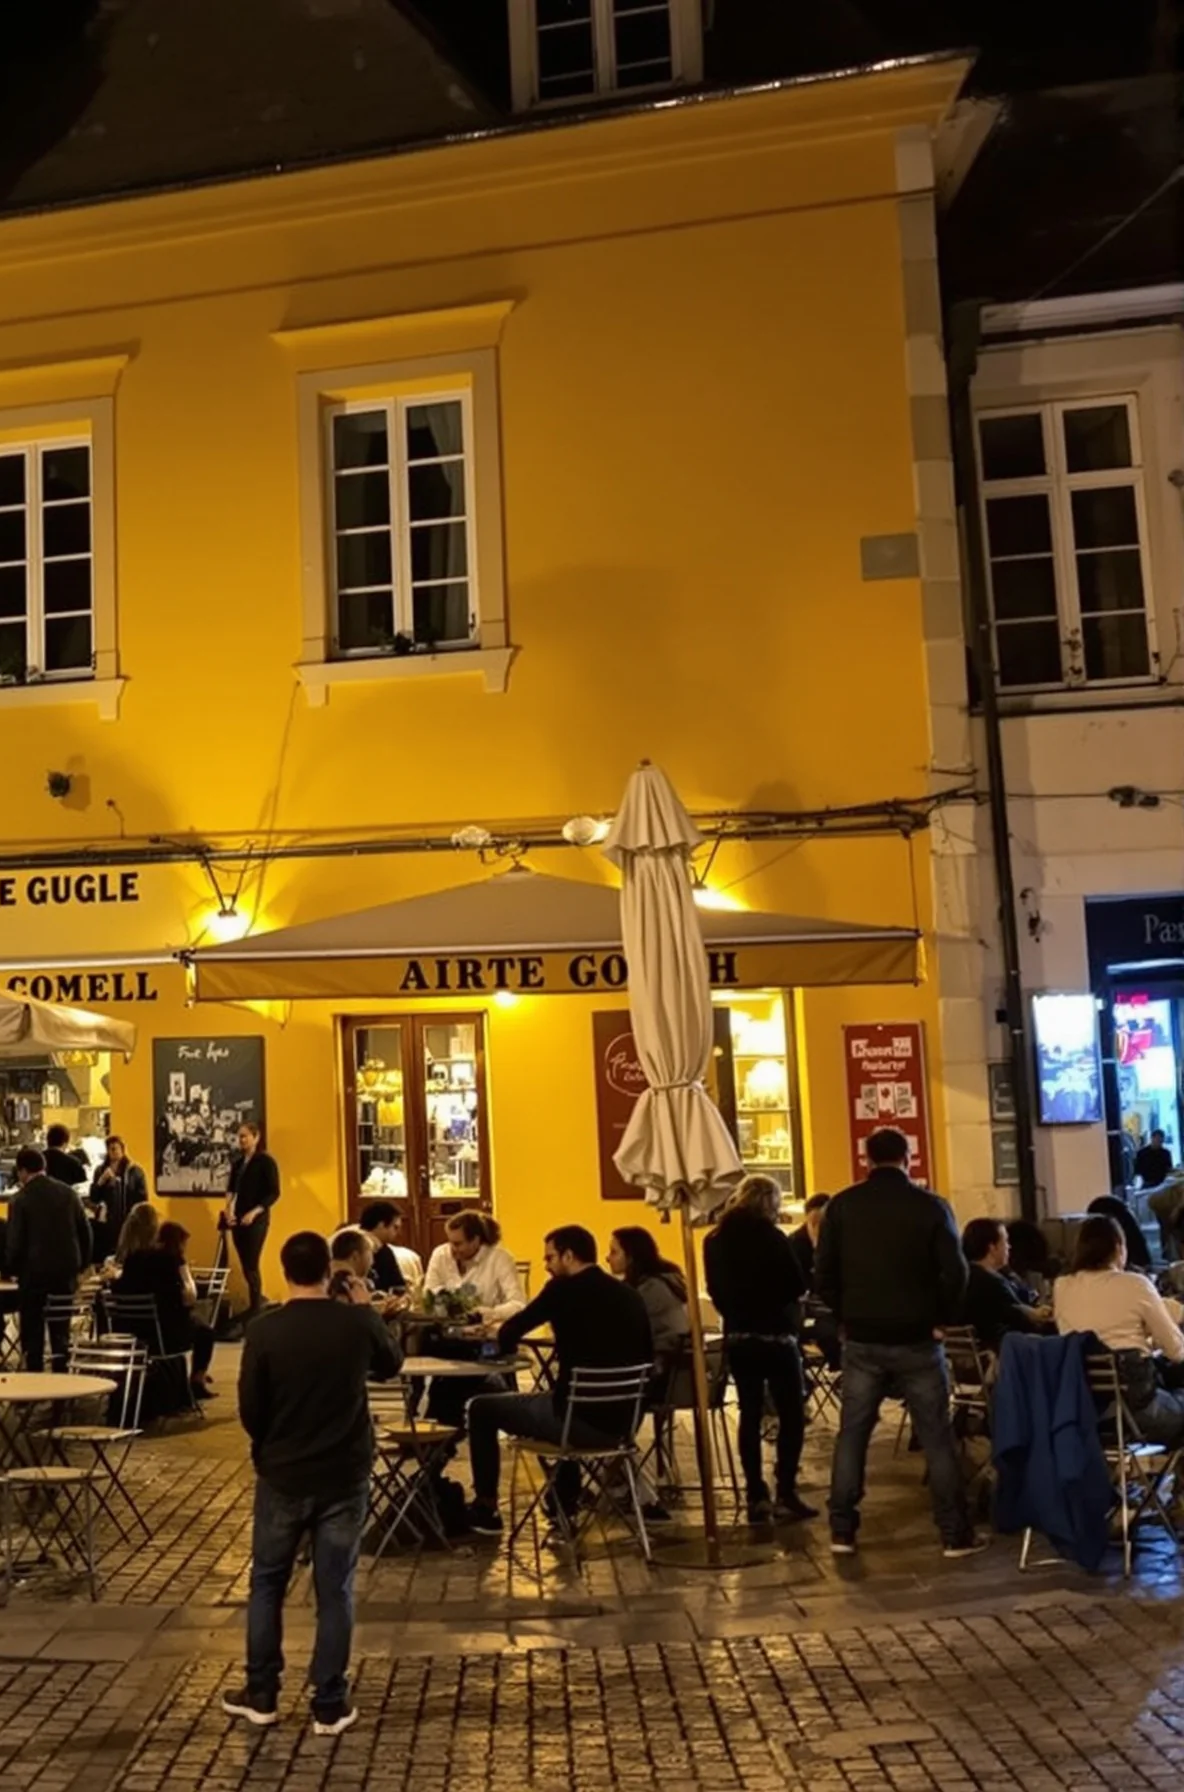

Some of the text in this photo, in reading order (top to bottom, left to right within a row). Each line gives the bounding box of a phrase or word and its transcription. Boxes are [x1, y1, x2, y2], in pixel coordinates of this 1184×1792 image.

[26, 872, 139, 906] GUGLE
[399, 952, 739, 990] AIRTE GOH
